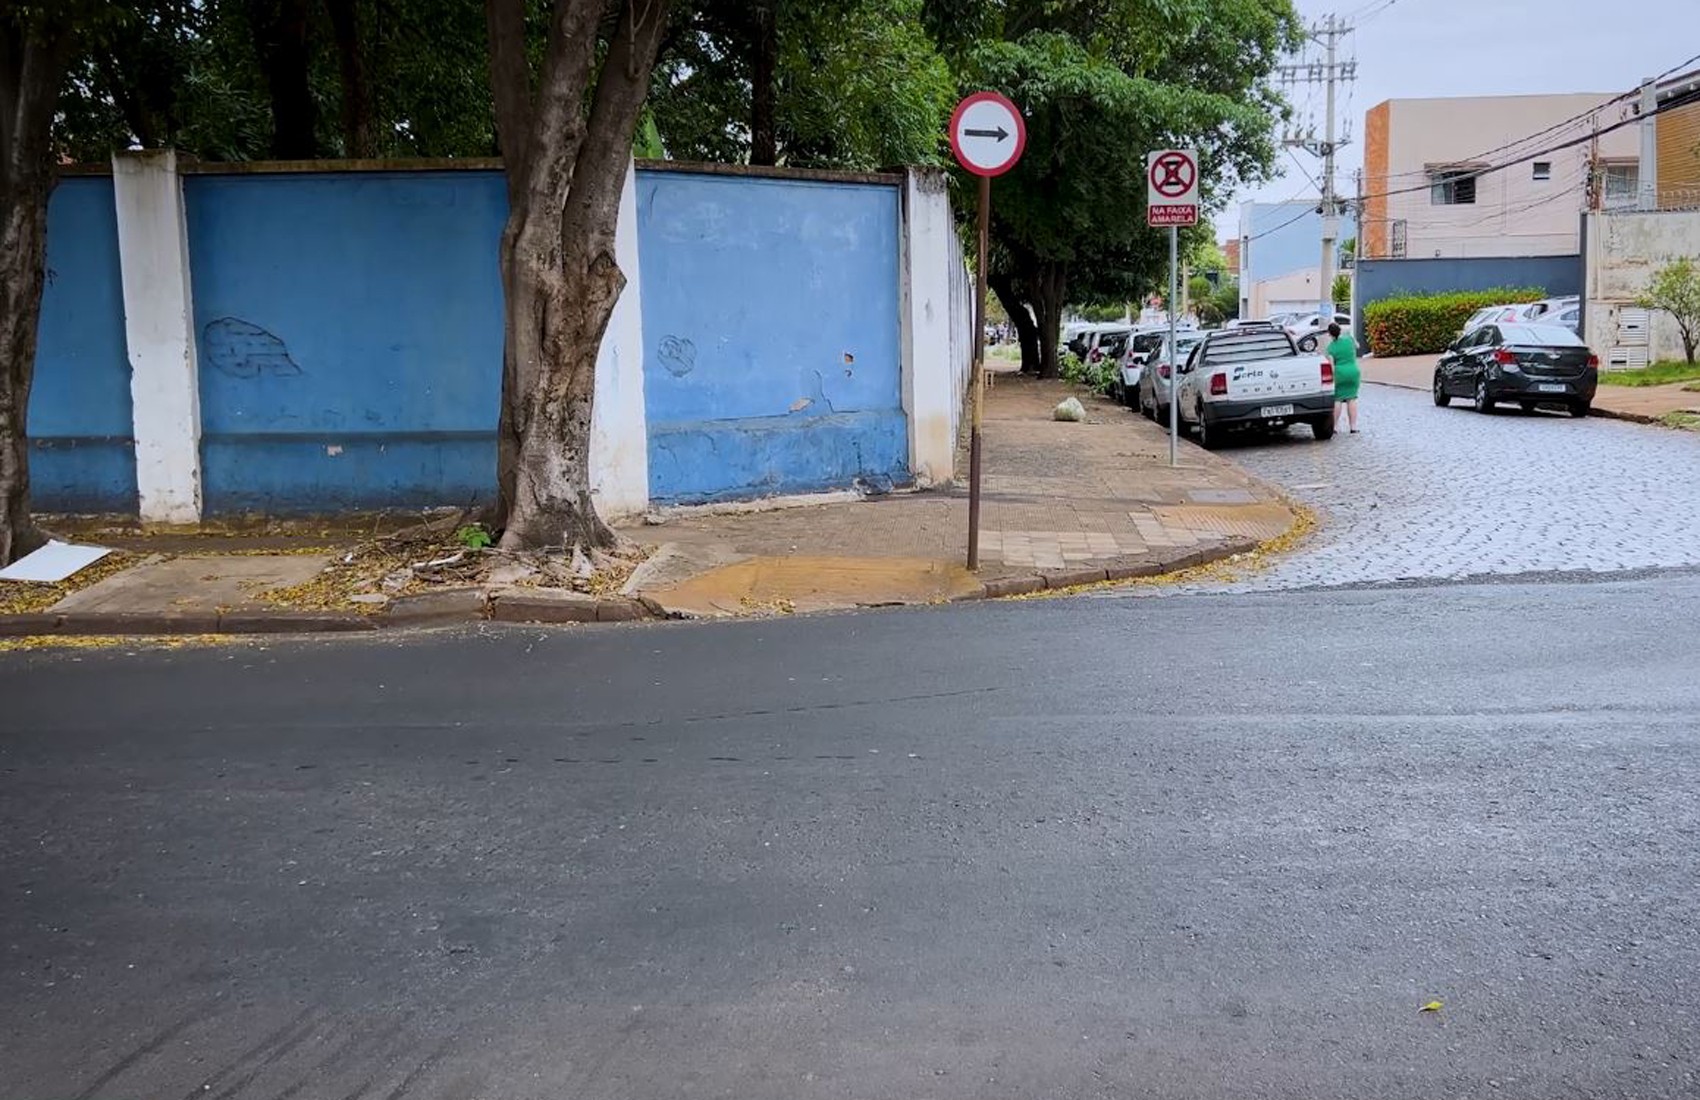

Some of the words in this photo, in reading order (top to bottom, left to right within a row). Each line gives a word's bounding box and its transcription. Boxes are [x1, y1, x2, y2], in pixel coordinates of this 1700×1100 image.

[1152, 207, 1165, 215] NA
[1167, 207, 1193, 215] FAIXA
[1151, 215, 1194, 223] AMARELA
